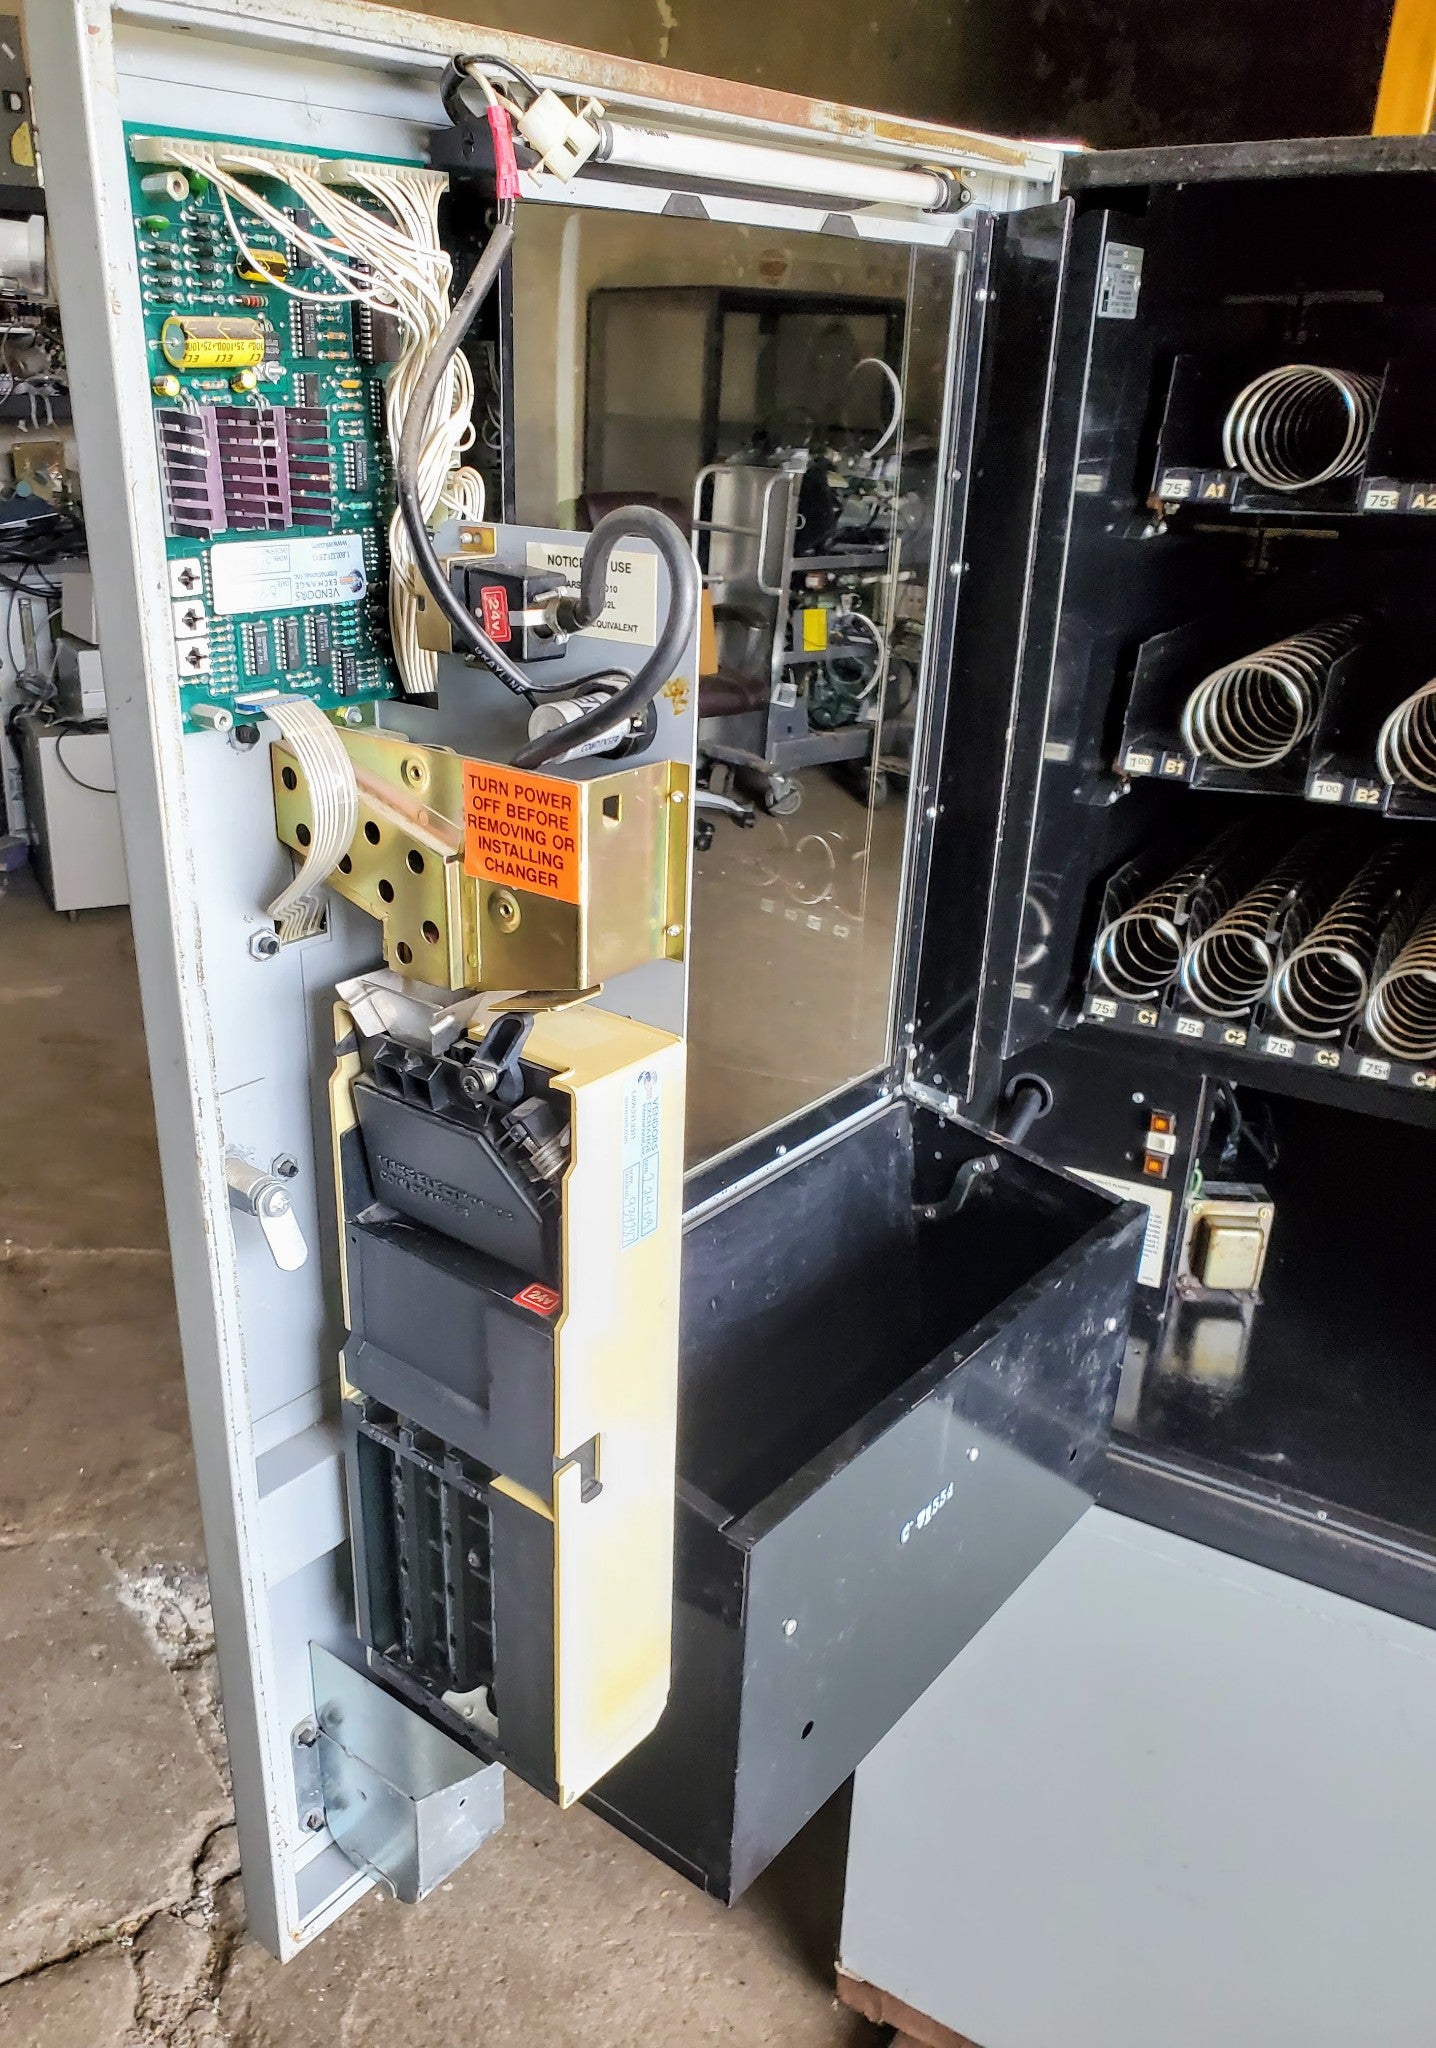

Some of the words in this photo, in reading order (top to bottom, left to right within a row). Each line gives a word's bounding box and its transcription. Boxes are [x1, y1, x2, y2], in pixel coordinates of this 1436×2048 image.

[1204, 483, 1226, 498] A1
[610, 561, 632, 574] USE
[294, 578, 338, 590] EXCHANGE
[295, 588, 340, 602] VENDORS
[1164, 758, 1184, 774] B1
[469, 774, 508, 798] TURN
[514, 784, 572, 812] POWER
[1355, 788, 1380, 804] B2
[472, 796, 501, 814] OFF
[506, 803, 569, 832] BEFORE
[468, 814, 546, 846] REMOVING
[552, 835, 574, 853] OR
[478, 836, 564, 870] INSTALLING
[484, 856, 558, 888] CHANGER
[1138, 1010, 1158, 1028] C1
[1224, 1029, 1247, 1045] C2
[1317, 1050, 1340, 1068] C3
[651, 1096, 659, 1152] VENDORS
